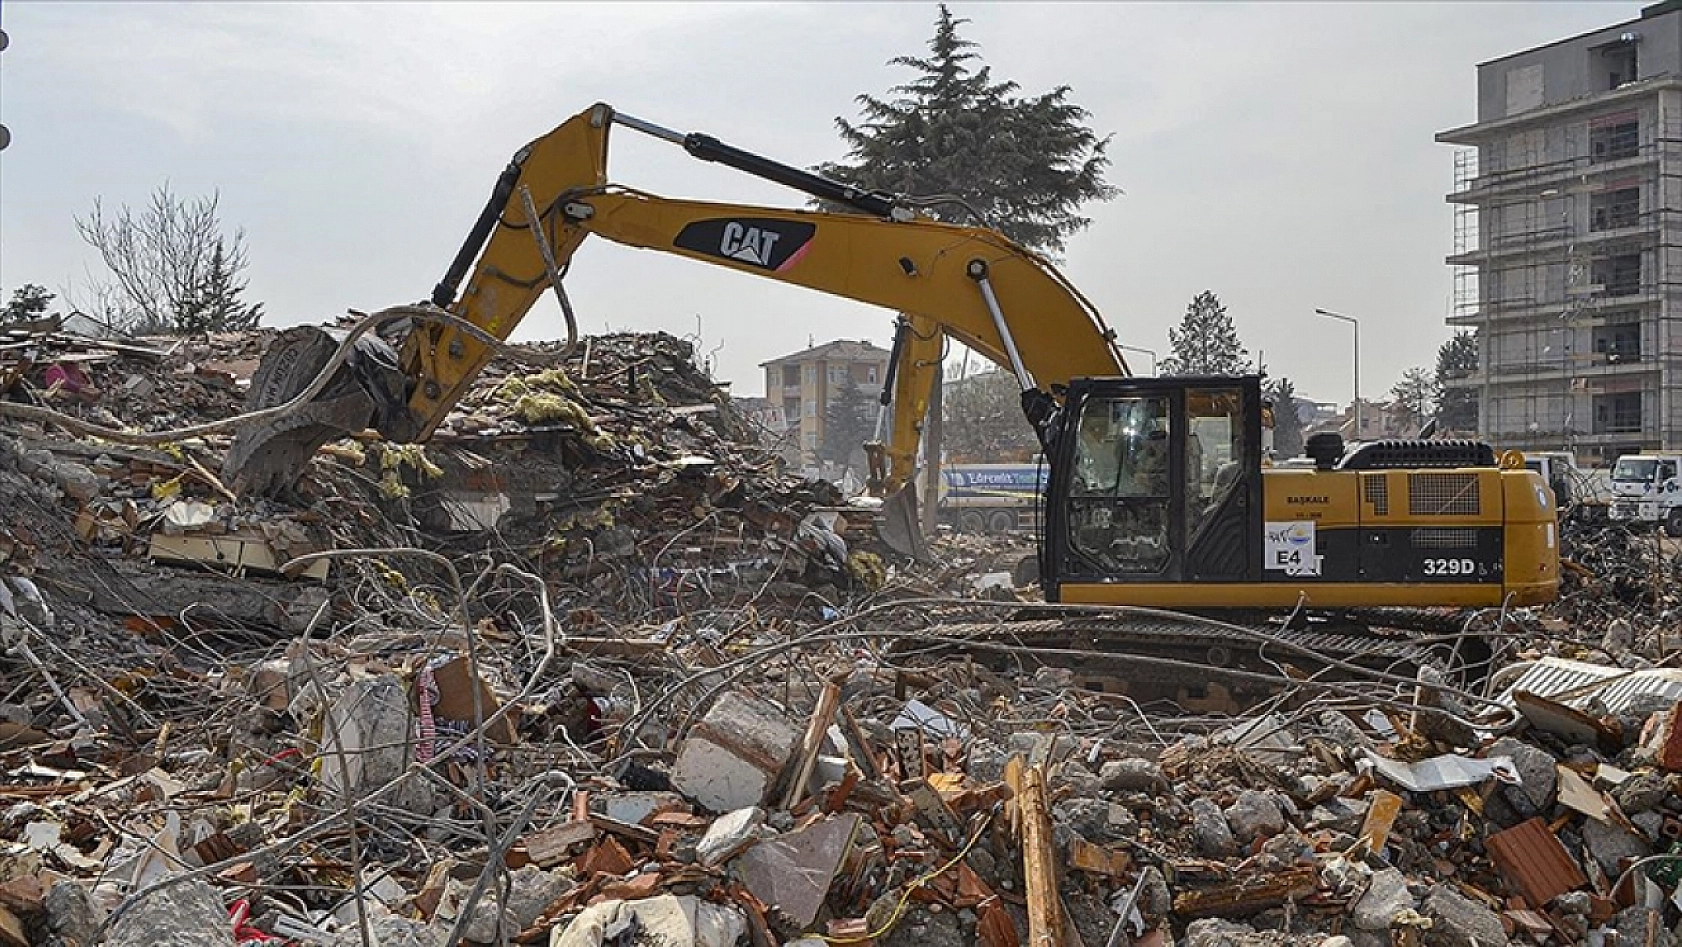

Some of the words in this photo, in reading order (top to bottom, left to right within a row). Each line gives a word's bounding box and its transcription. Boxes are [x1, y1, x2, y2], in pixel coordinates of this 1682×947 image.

[720, 221, 780, 265] CAT
[1277, 550, 1301, 566] E4
[1424, 558, 1475, 575] 329D
